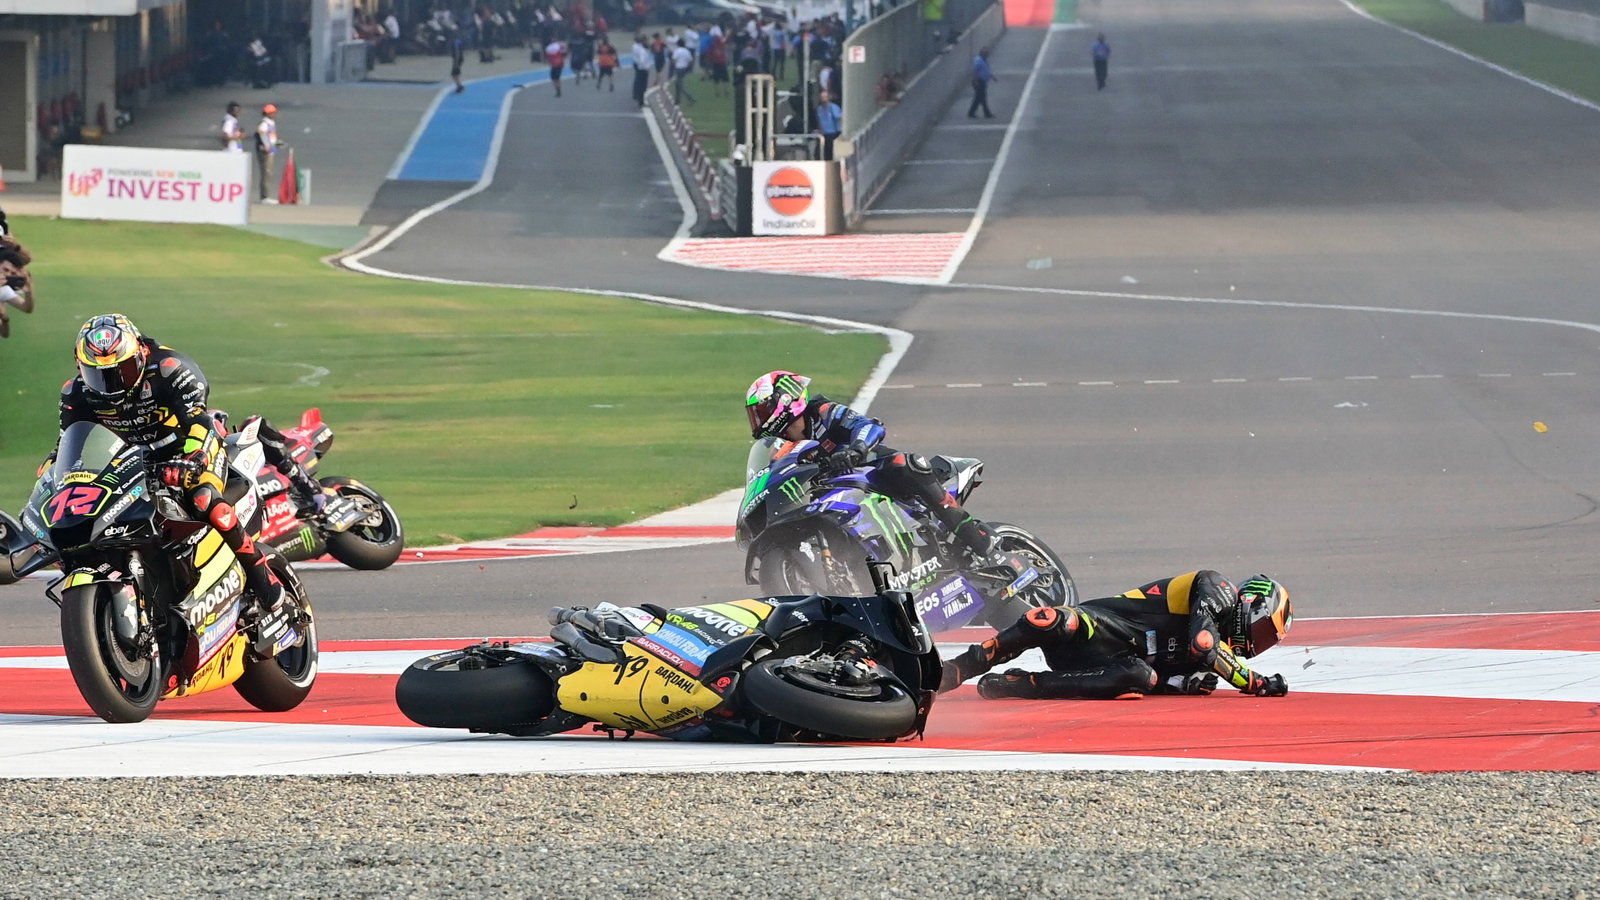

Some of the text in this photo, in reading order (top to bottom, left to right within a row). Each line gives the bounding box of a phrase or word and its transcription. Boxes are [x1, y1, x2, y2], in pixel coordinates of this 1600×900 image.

[853, 48, 862, 61] F
[108, 179, 244, 203] INVEST UP
[105, 525, 129, 536] ebay
[889, 556, 942, 590] MONSTER
[915, 592, 940, 616] EOS
[636, 637, 685, 665] BARRACUDA
[655, 666, 695, 694] BARDAHL
